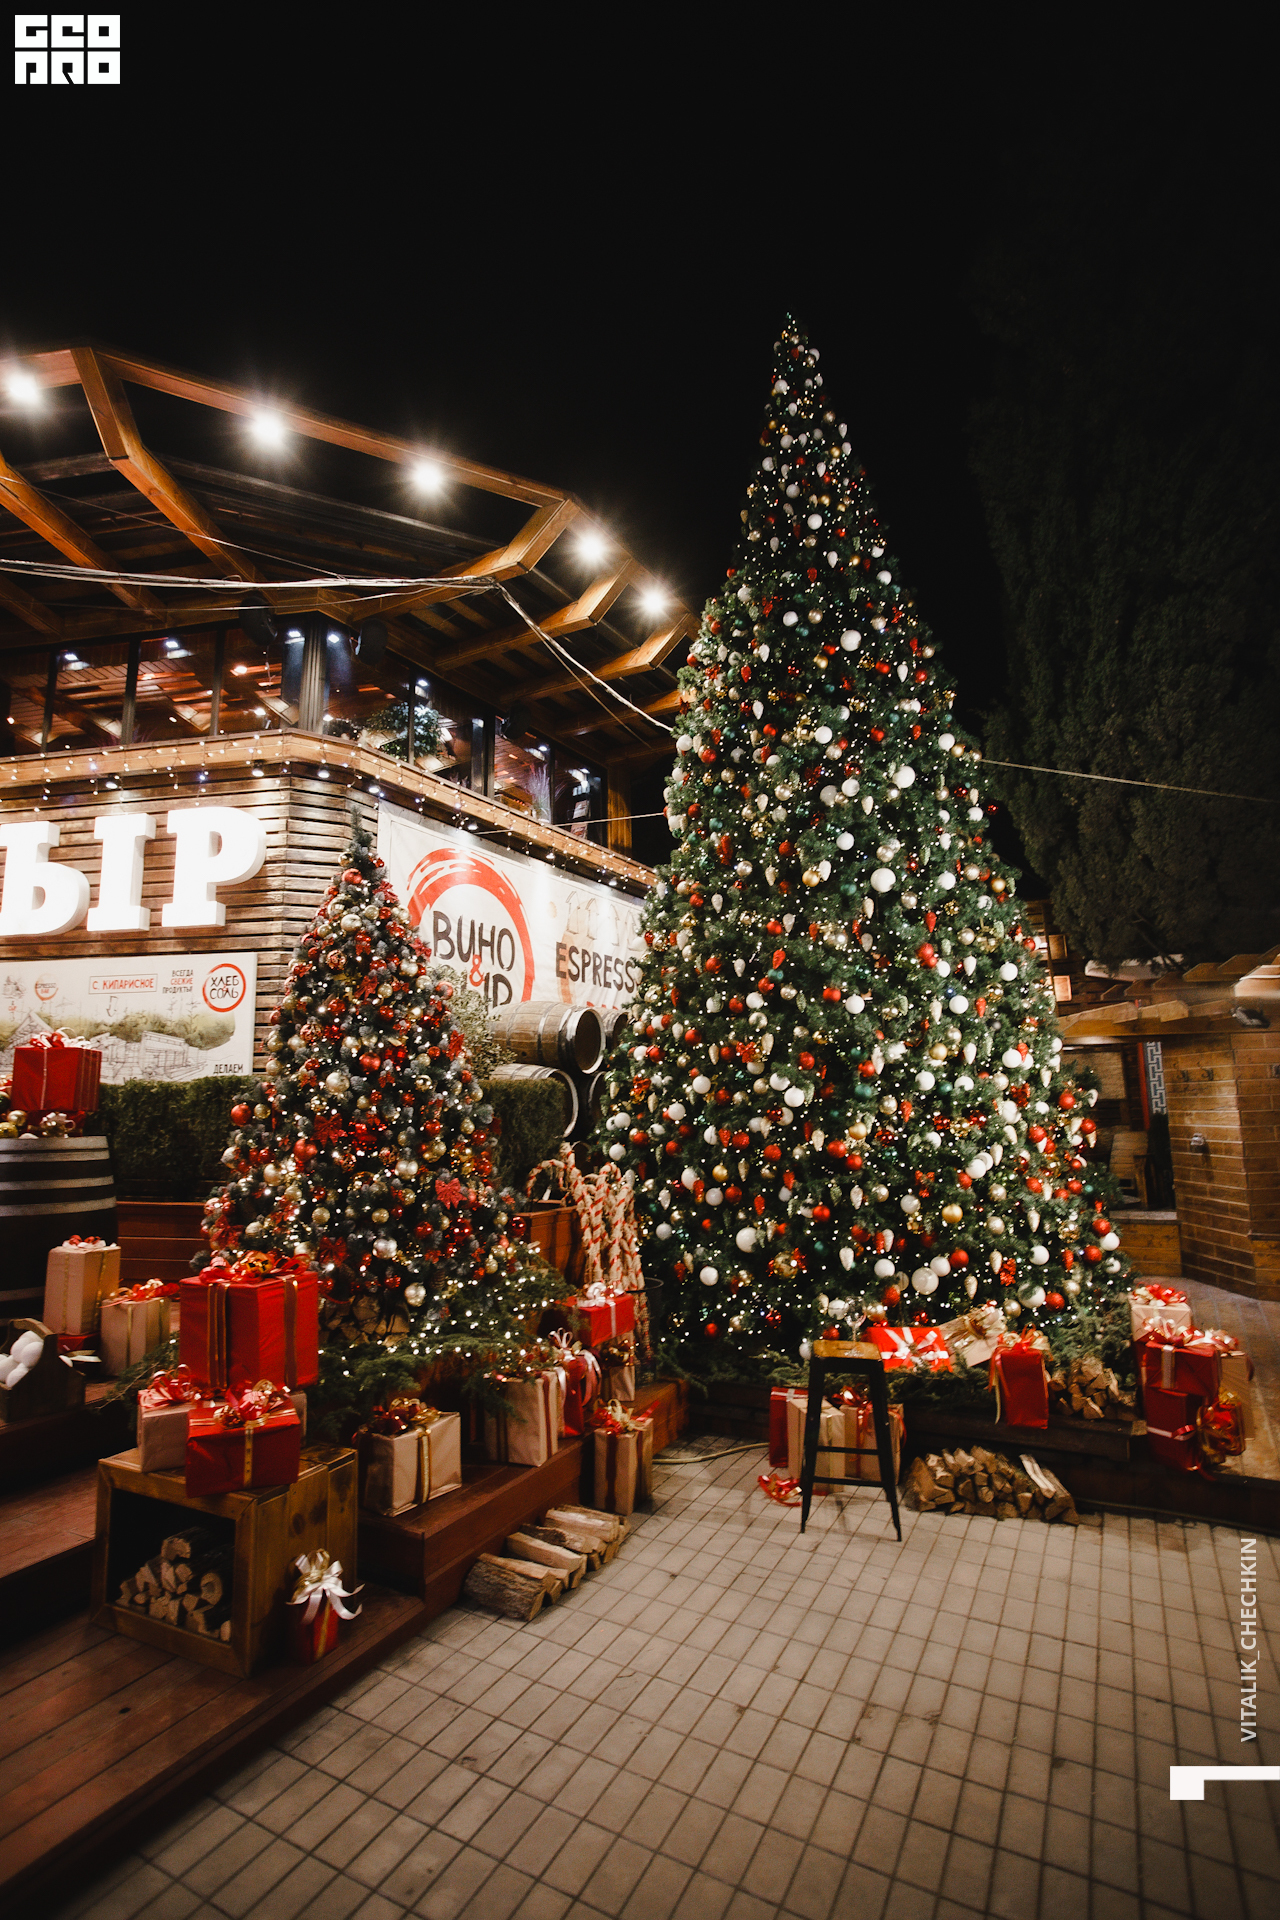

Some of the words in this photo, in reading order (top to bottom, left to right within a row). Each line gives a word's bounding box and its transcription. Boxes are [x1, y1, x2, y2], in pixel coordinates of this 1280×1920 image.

[172, 969, 194, 977] ВСЕГДА
[469, 954, 487, 987] &
[555, 941, 638, 994] ESPRESS
[102, 978, 155, 990] КИПАРИСНОЕ
[170, 977, 194, 985] СВЕЖИЕ
[210, 975, 240, 987] ХЛЕБ
[209, 986, 239, 1000] СОЛЬ
[213, 1063, 244, 1075] ДЕЛАЕМ
